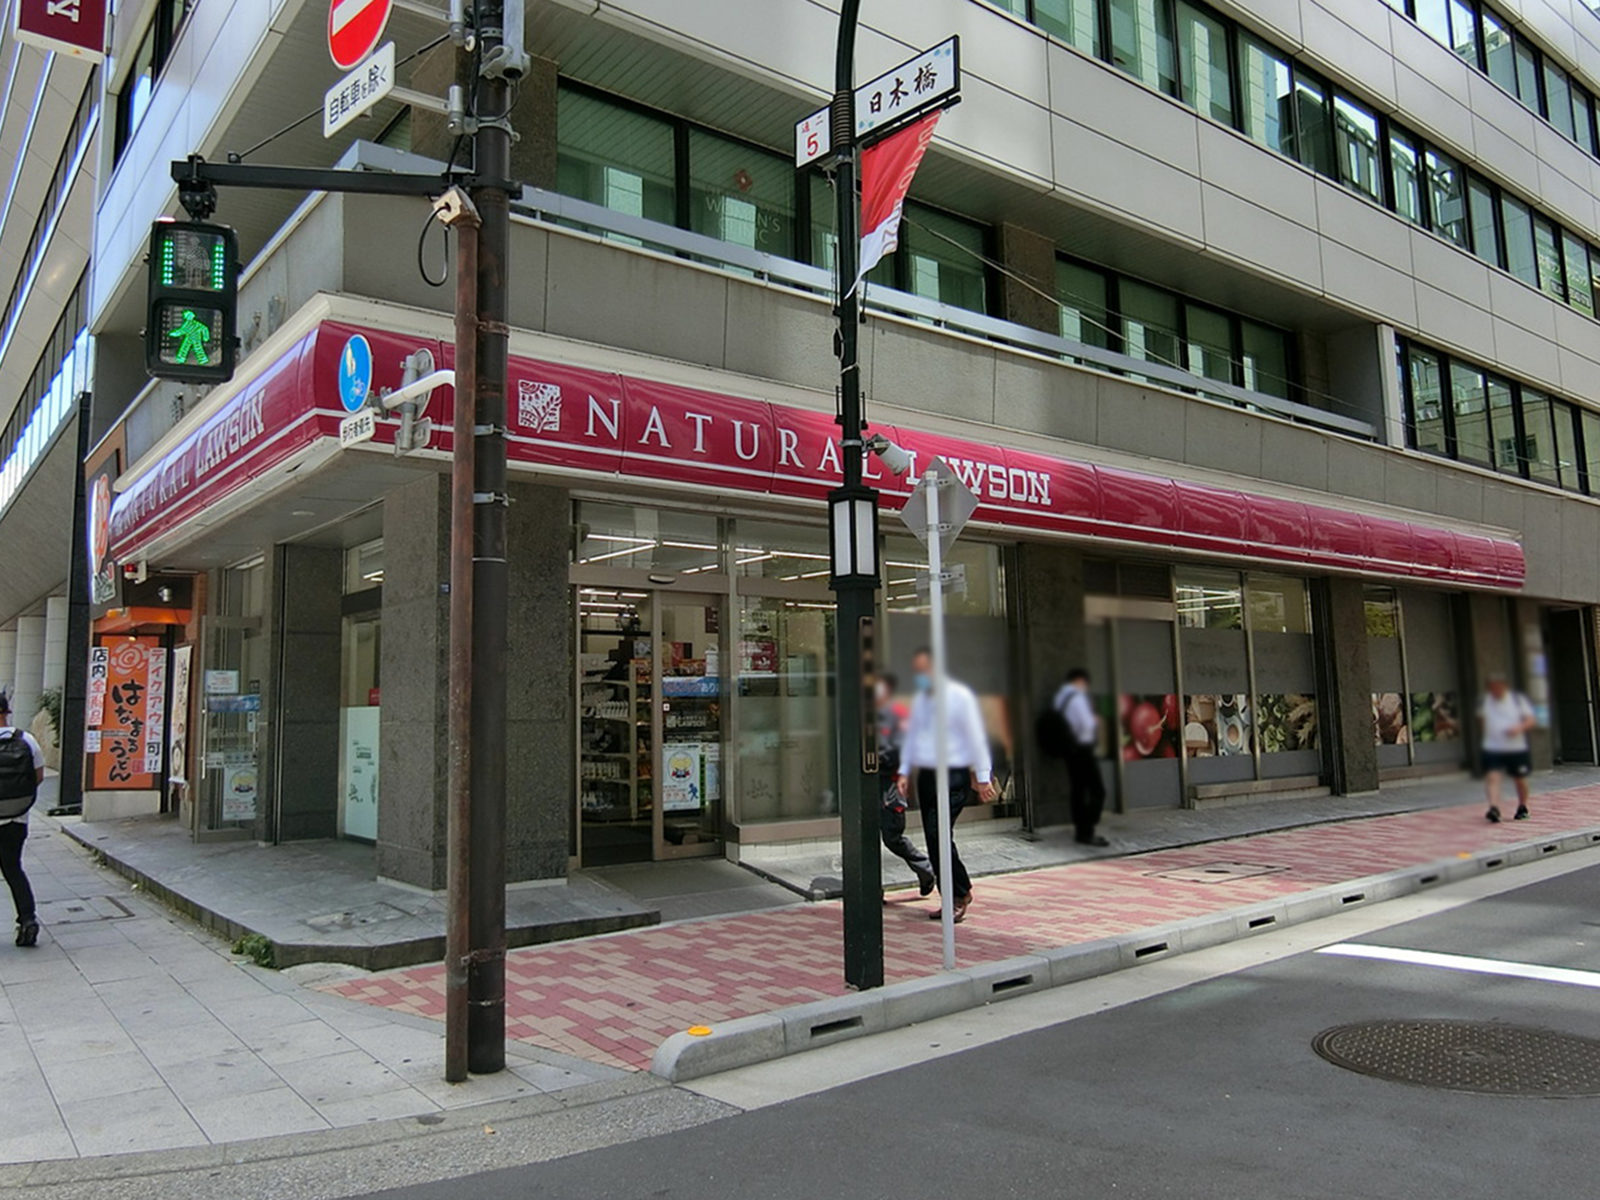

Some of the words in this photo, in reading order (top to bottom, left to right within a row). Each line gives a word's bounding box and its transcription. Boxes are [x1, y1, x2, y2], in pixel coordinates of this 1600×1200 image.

[869, 62, 938, 114] 日本橋
[807, 133, 819, 156] 5
[195, 388, 265, 478] LAWSON
[584, 394, 882, 480] NATURAL
[906, 450, 1051, 505] LWSON
